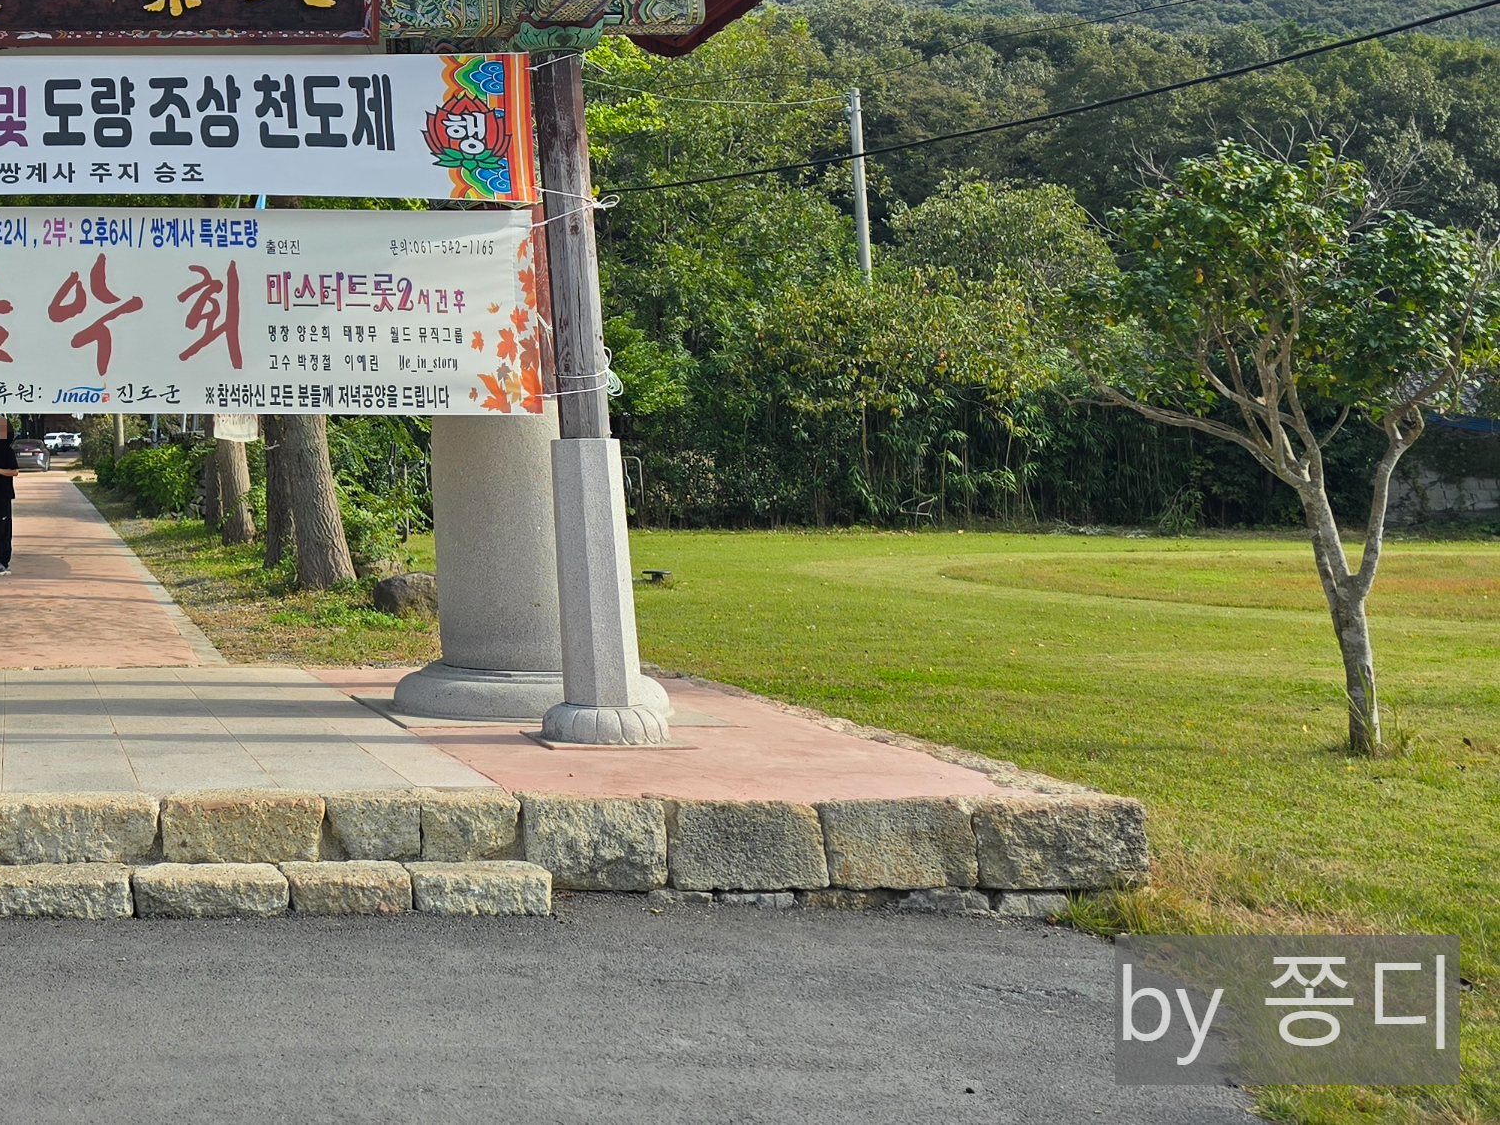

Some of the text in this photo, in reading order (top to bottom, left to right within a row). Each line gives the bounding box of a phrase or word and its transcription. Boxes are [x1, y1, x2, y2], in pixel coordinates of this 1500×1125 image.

[42, 77, 135, 148] 도량
[149, 74, 241, 149] 조상
[254, 73, 396, 151] 천도제
[443, 112, 486, 156] 행
[89, 161, 140, 184] 주지
[153, 161, 205, 184] 승조
[43, 218, 73, 247] 2부:
[79, 216, 133, 248] 오후6시
[150, 217, 195, 248] 쌍계사
[200, 217, 259, 248] 특설도량
[266, 239, 300, 255] 출연진
[266, 271, 466, 314] 미스터트롯2 서건후
[268, 325, 289, 343] 명창
[297, 325, 331, 343] 양은희
[343, 325, 377, 343] 태평무
[269, 354, 291, 371] 고수
[297, 354, 332, 371] 박정철
[344, 354, 379, 372] 이예린
[52, 387, 100, 405] Jindo
[116, 382, 181, 405] 진도군
[269, 384, 294, 408] 모든
[298, 383, 334, 408] 분들께
[338, 384, 398, 409] 저녁공양을
[402, 384, 450, 409] 드립니다
